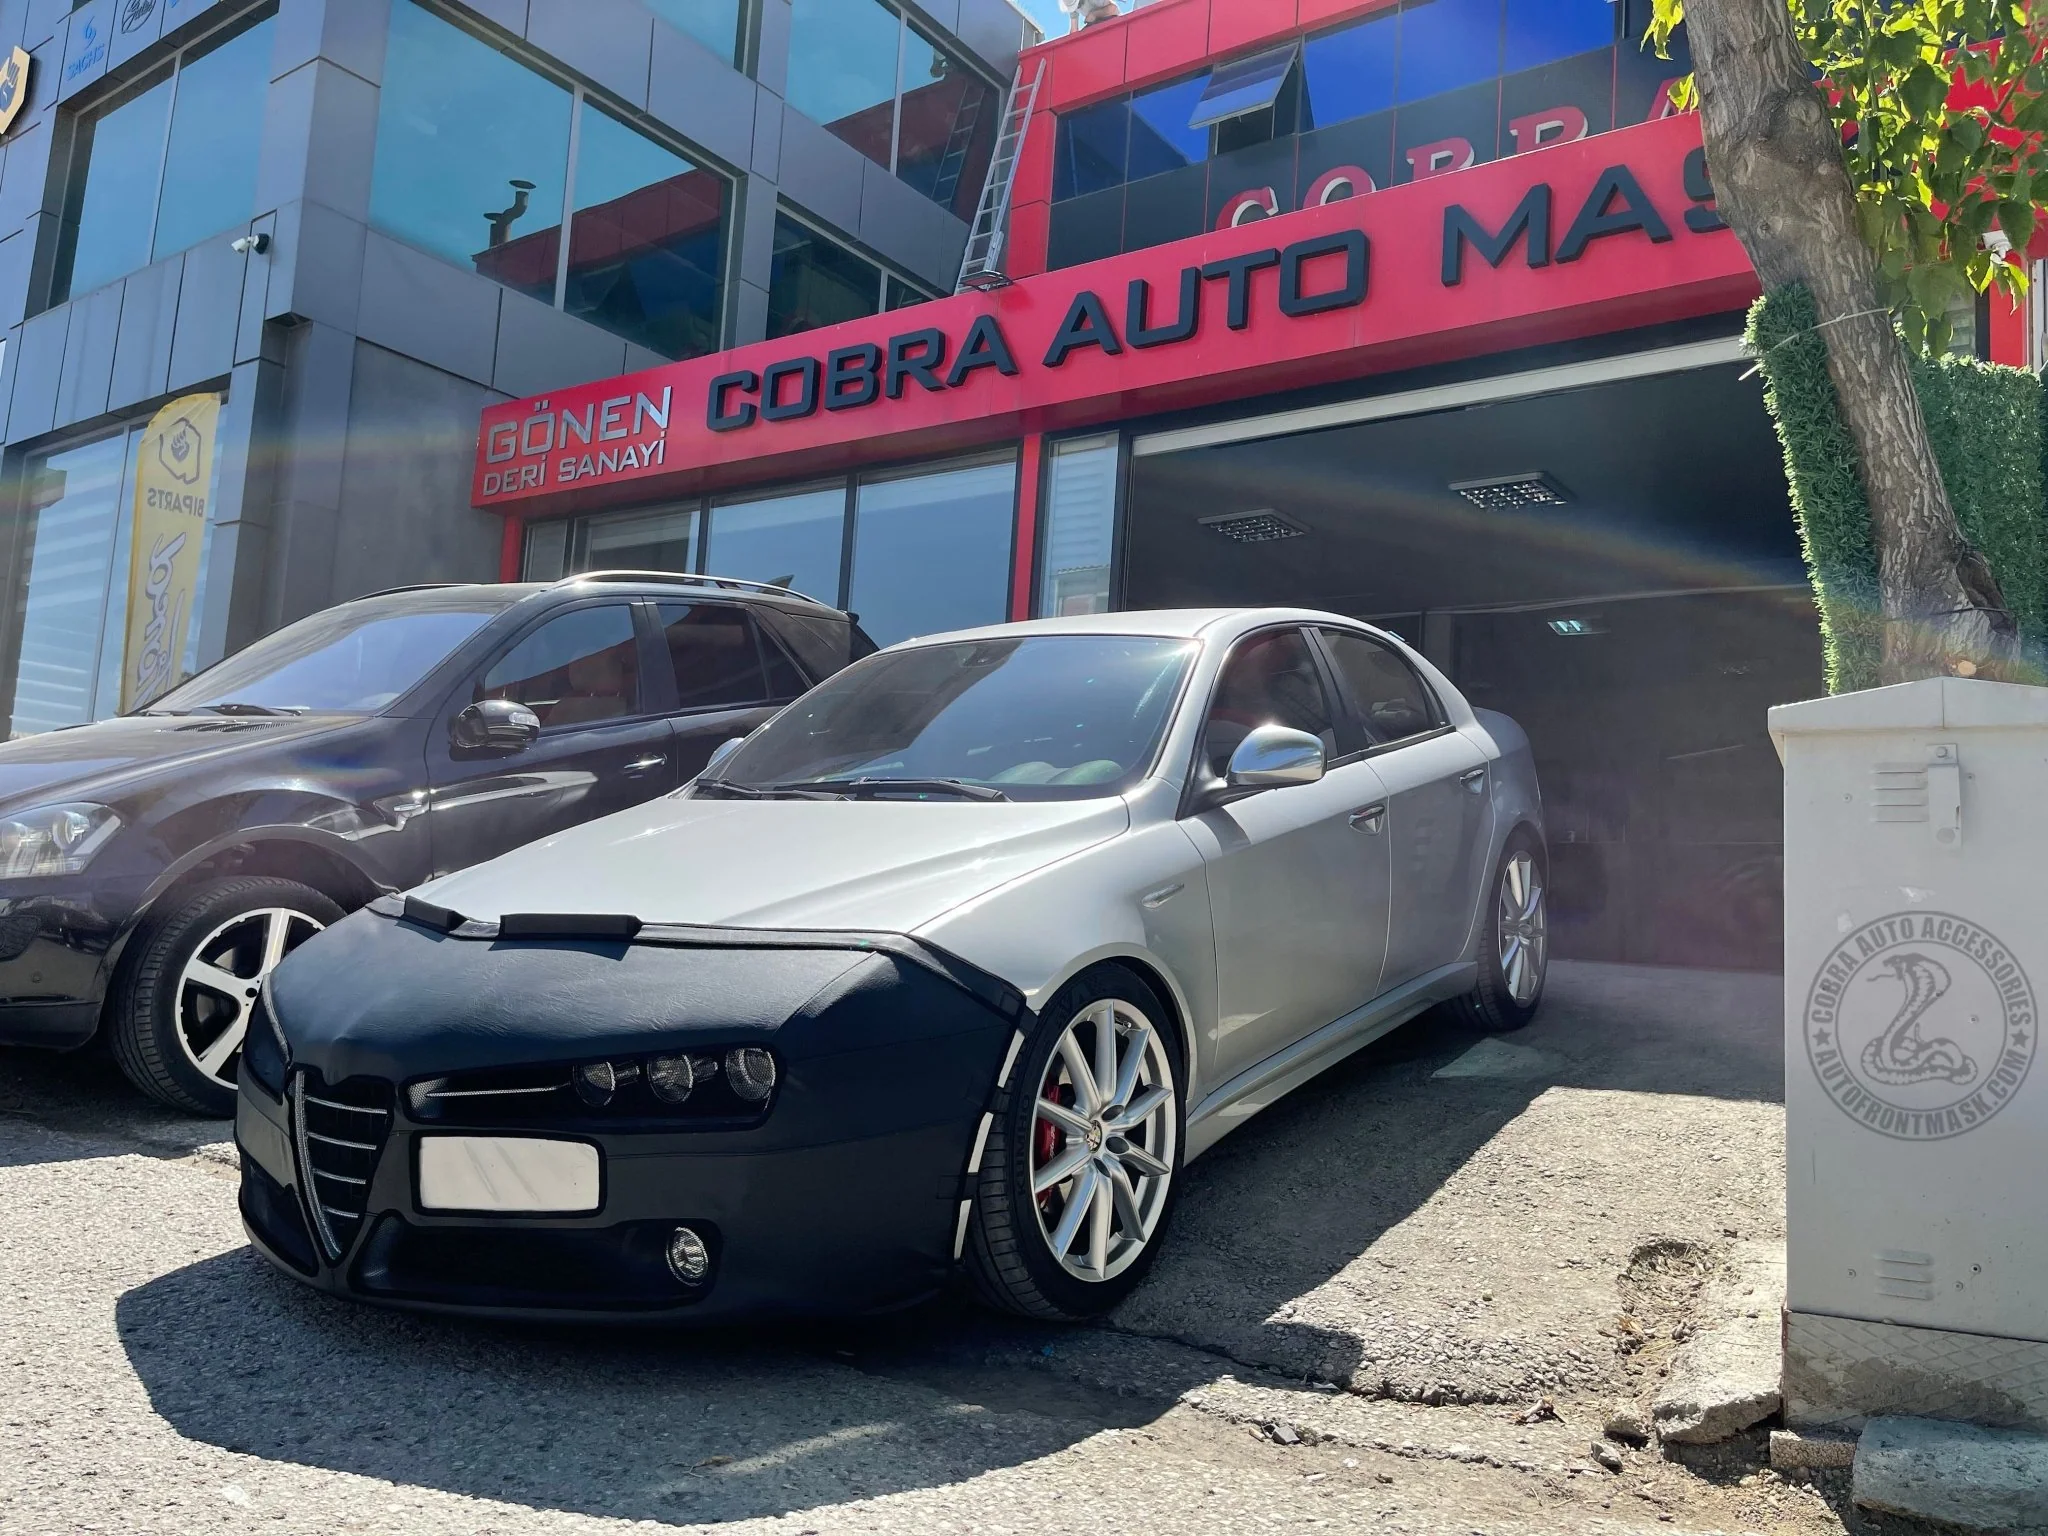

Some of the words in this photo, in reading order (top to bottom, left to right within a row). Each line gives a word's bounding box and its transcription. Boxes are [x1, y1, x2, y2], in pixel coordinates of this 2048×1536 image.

[706, 314, 1018, 432] COBRA
[1042, 228, 1370, 368] AUTO
[482, 454, 547, 496] DERİ
[557, 430, 666, 482] SANAYİ
[486, 385, 672, 464] GÖNEN
